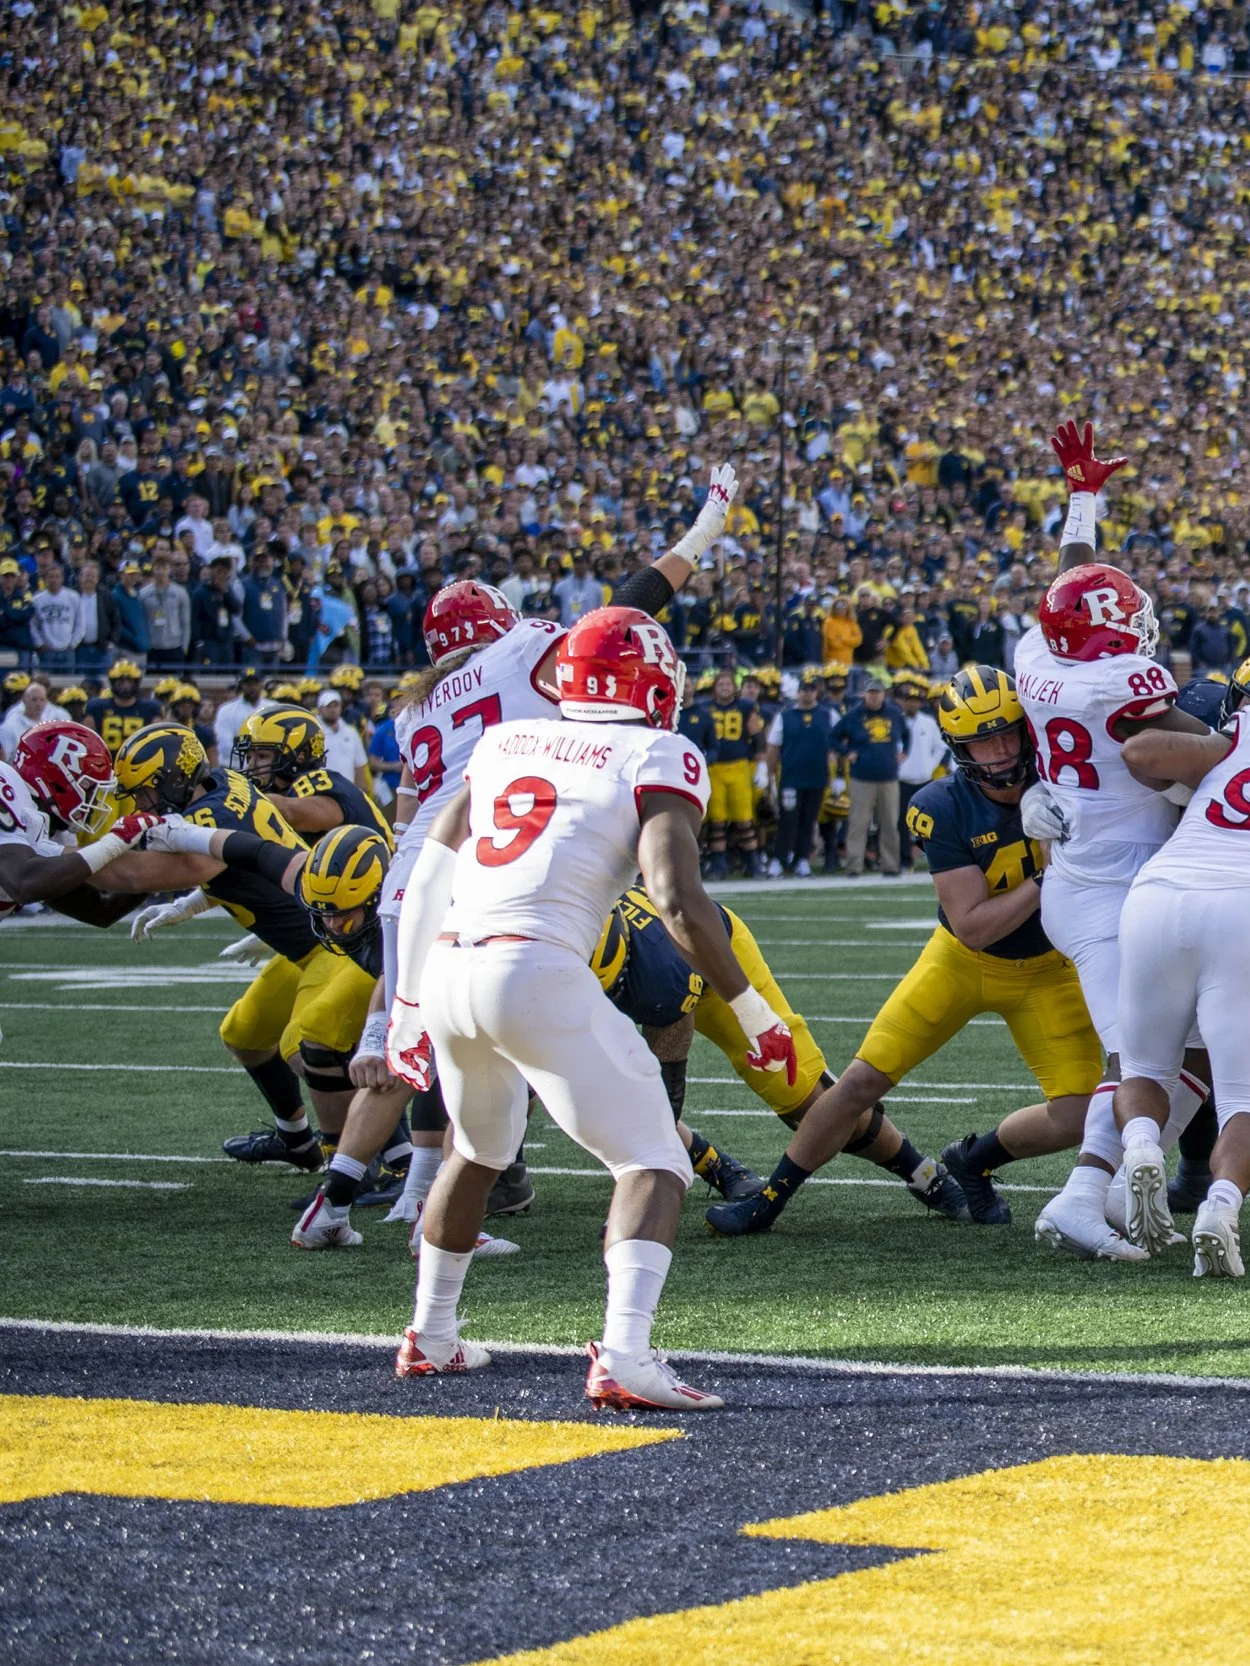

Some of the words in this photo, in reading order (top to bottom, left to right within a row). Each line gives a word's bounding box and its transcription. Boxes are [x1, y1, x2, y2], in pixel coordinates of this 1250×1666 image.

[1082, 588, 1127, 627] R
[439, 626, 459, 647] 97
[630, 624, 676, 666] R
[587, 675, 599, 695] 9
[1128, 666, 1167, 697] 88
[986, 719, 998, 729] M
[48, 735, 88, 775] R
[410, 692, 502, 805] 97
[498, 734, 613, 769] ADDOX-WILLIAMS
[293, 770, 333, 799] 83
[683, 752, 701, 786] 9
[475, 776, 557, 868] 9
[906, 806, 934, 840] 49
[317, 902, 326, 910] M
